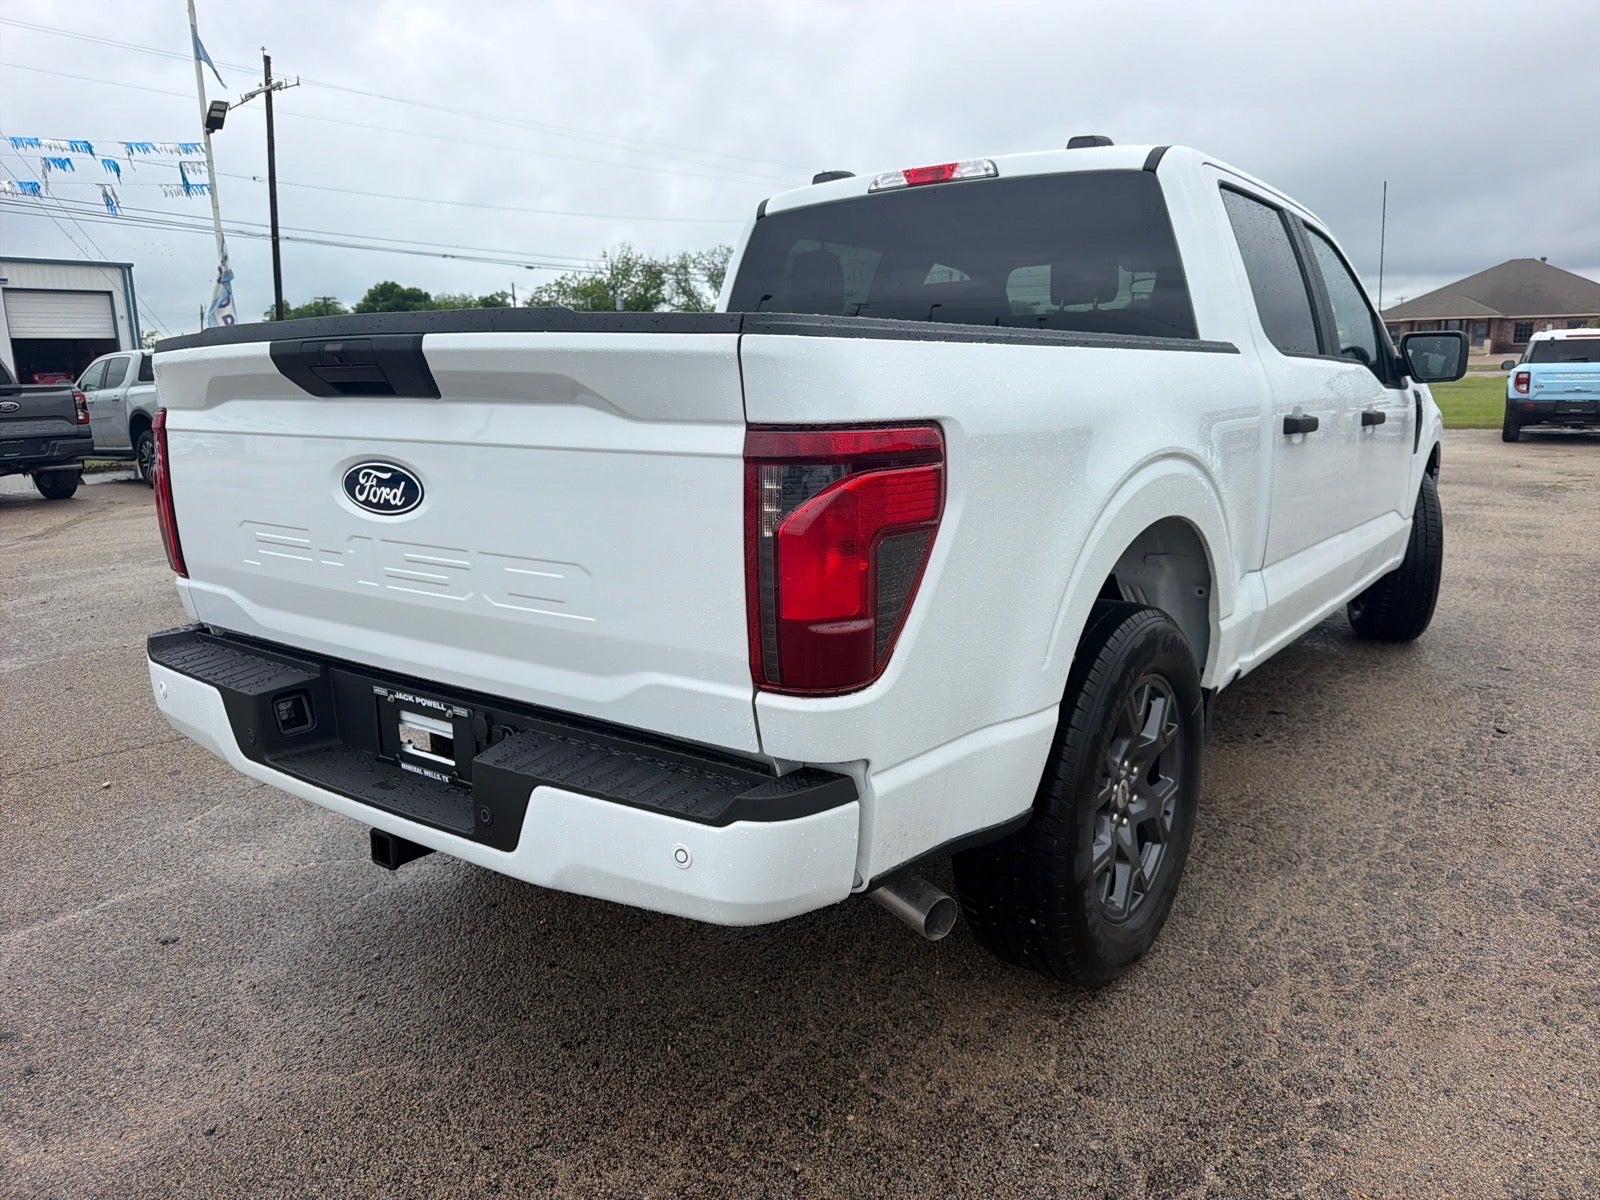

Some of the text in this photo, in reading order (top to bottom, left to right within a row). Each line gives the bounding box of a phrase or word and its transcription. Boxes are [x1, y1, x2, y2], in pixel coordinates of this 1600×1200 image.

[355, 468, 405, 507] Ford
[239, 519, 597, 623] F-150
[394, 691, 414, 703] JACK
[415, 696, 447, 711] POWELL
[401, 762, 423, 776] MINERAL
[442, 775, 450, 783] TX
